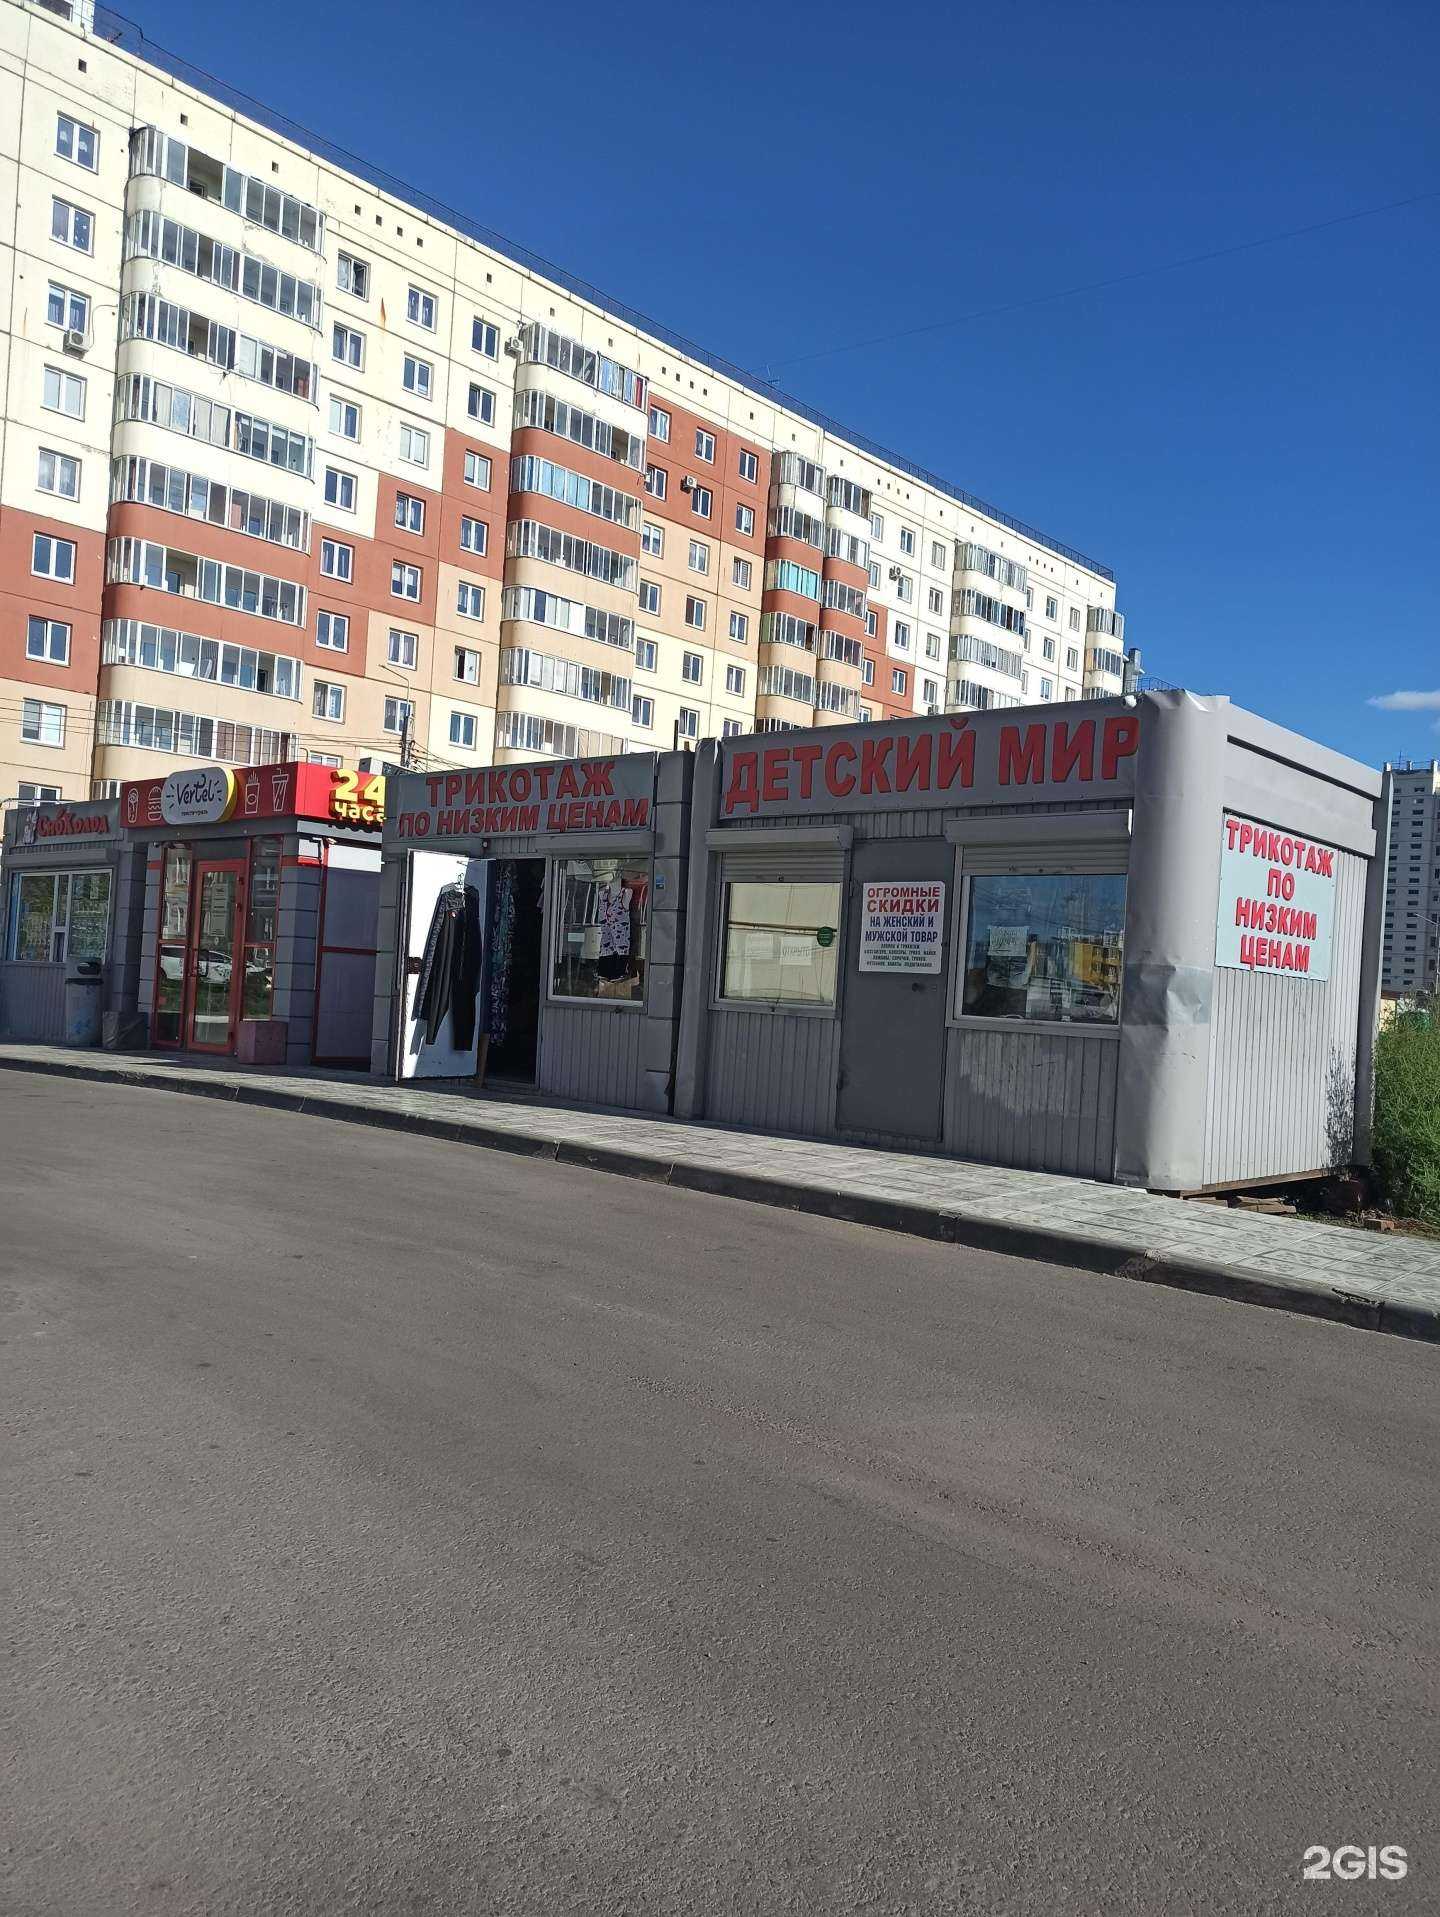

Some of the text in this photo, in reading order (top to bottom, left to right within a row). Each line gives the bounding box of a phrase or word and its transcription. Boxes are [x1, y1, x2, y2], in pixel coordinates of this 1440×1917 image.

[724, 715, 1140, 813] ДЕТСКИЙ МИР
[176, 773, 215, 806] Vertel
[330, 768, 386, 808] 24
[426, 761, 616, 807] ТРИКОТАЖ
[399, 798, 649, 837] ПО НИЗКИМ ЦЕНАМ
[1226, 818, 1335, 878] ТРИКОТАЖ
[867, 886, 941, 898] ОГРОМНЫЕ
[1267, 867, 1296, 901] ПО
[867, 899, 939, 915] СКИДКИ
[870, 913, 934, 928] НА ЖЕНСКИЙ И
[1235, 896, 1317, 941] НИЗКИМ
[865, 928, 938, 943] МУЖСКОЙ ТОВАР
[1240, 934, 1310, 972] ЦЕНАМ
